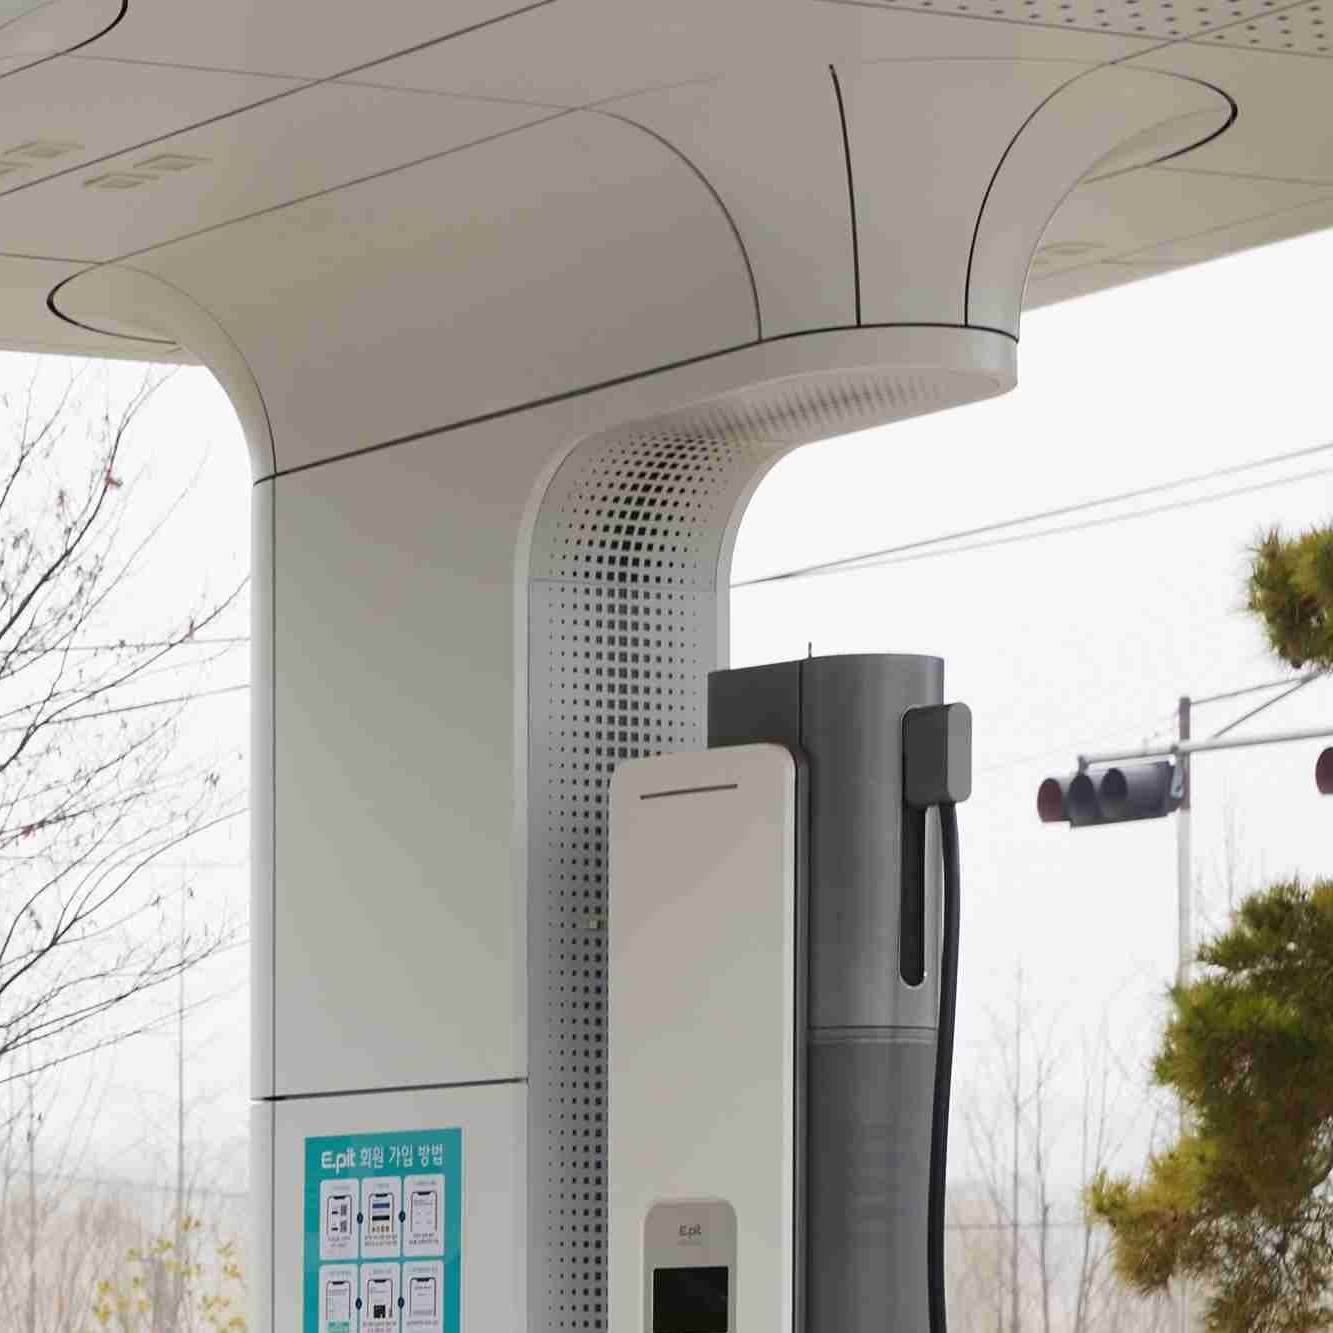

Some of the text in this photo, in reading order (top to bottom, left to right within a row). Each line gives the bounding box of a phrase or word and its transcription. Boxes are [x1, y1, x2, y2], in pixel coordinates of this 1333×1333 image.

[359, 1146, 383, 1169] 회원
[389, 1145, 414, 1168] 가입
[418, 1144, 443, 1167] 방법
